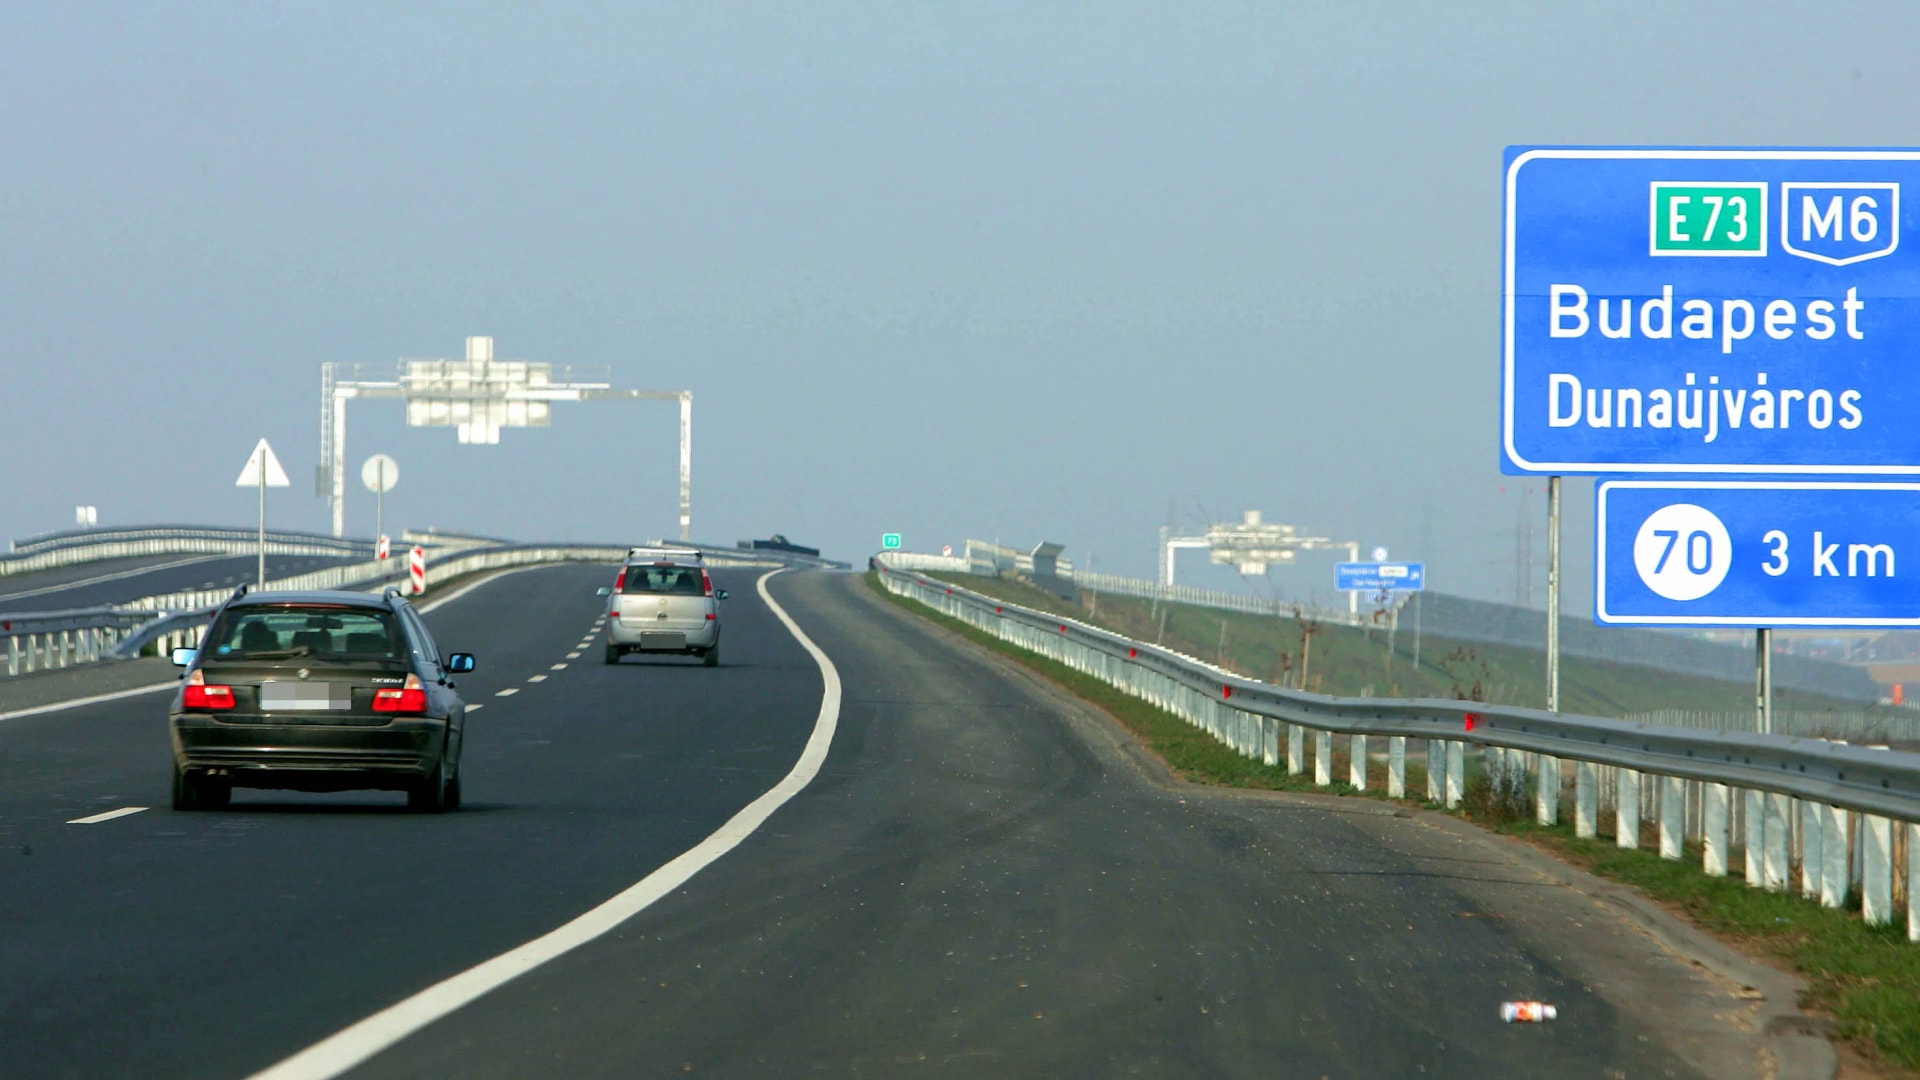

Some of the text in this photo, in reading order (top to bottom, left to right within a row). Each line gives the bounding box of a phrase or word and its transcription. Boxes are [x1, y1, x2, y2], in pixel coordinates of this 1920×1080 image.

[1669, 196, 1748, 242] E 73
[1802, 195, 1878, 243] M6
[1549, 283, 1865, 354] Budapest
[1548, 372, 1864, 444] Dunaújváros
[1653, 529, 1713, 576] 70
[1761, 529, 1896, 577] 3 km
